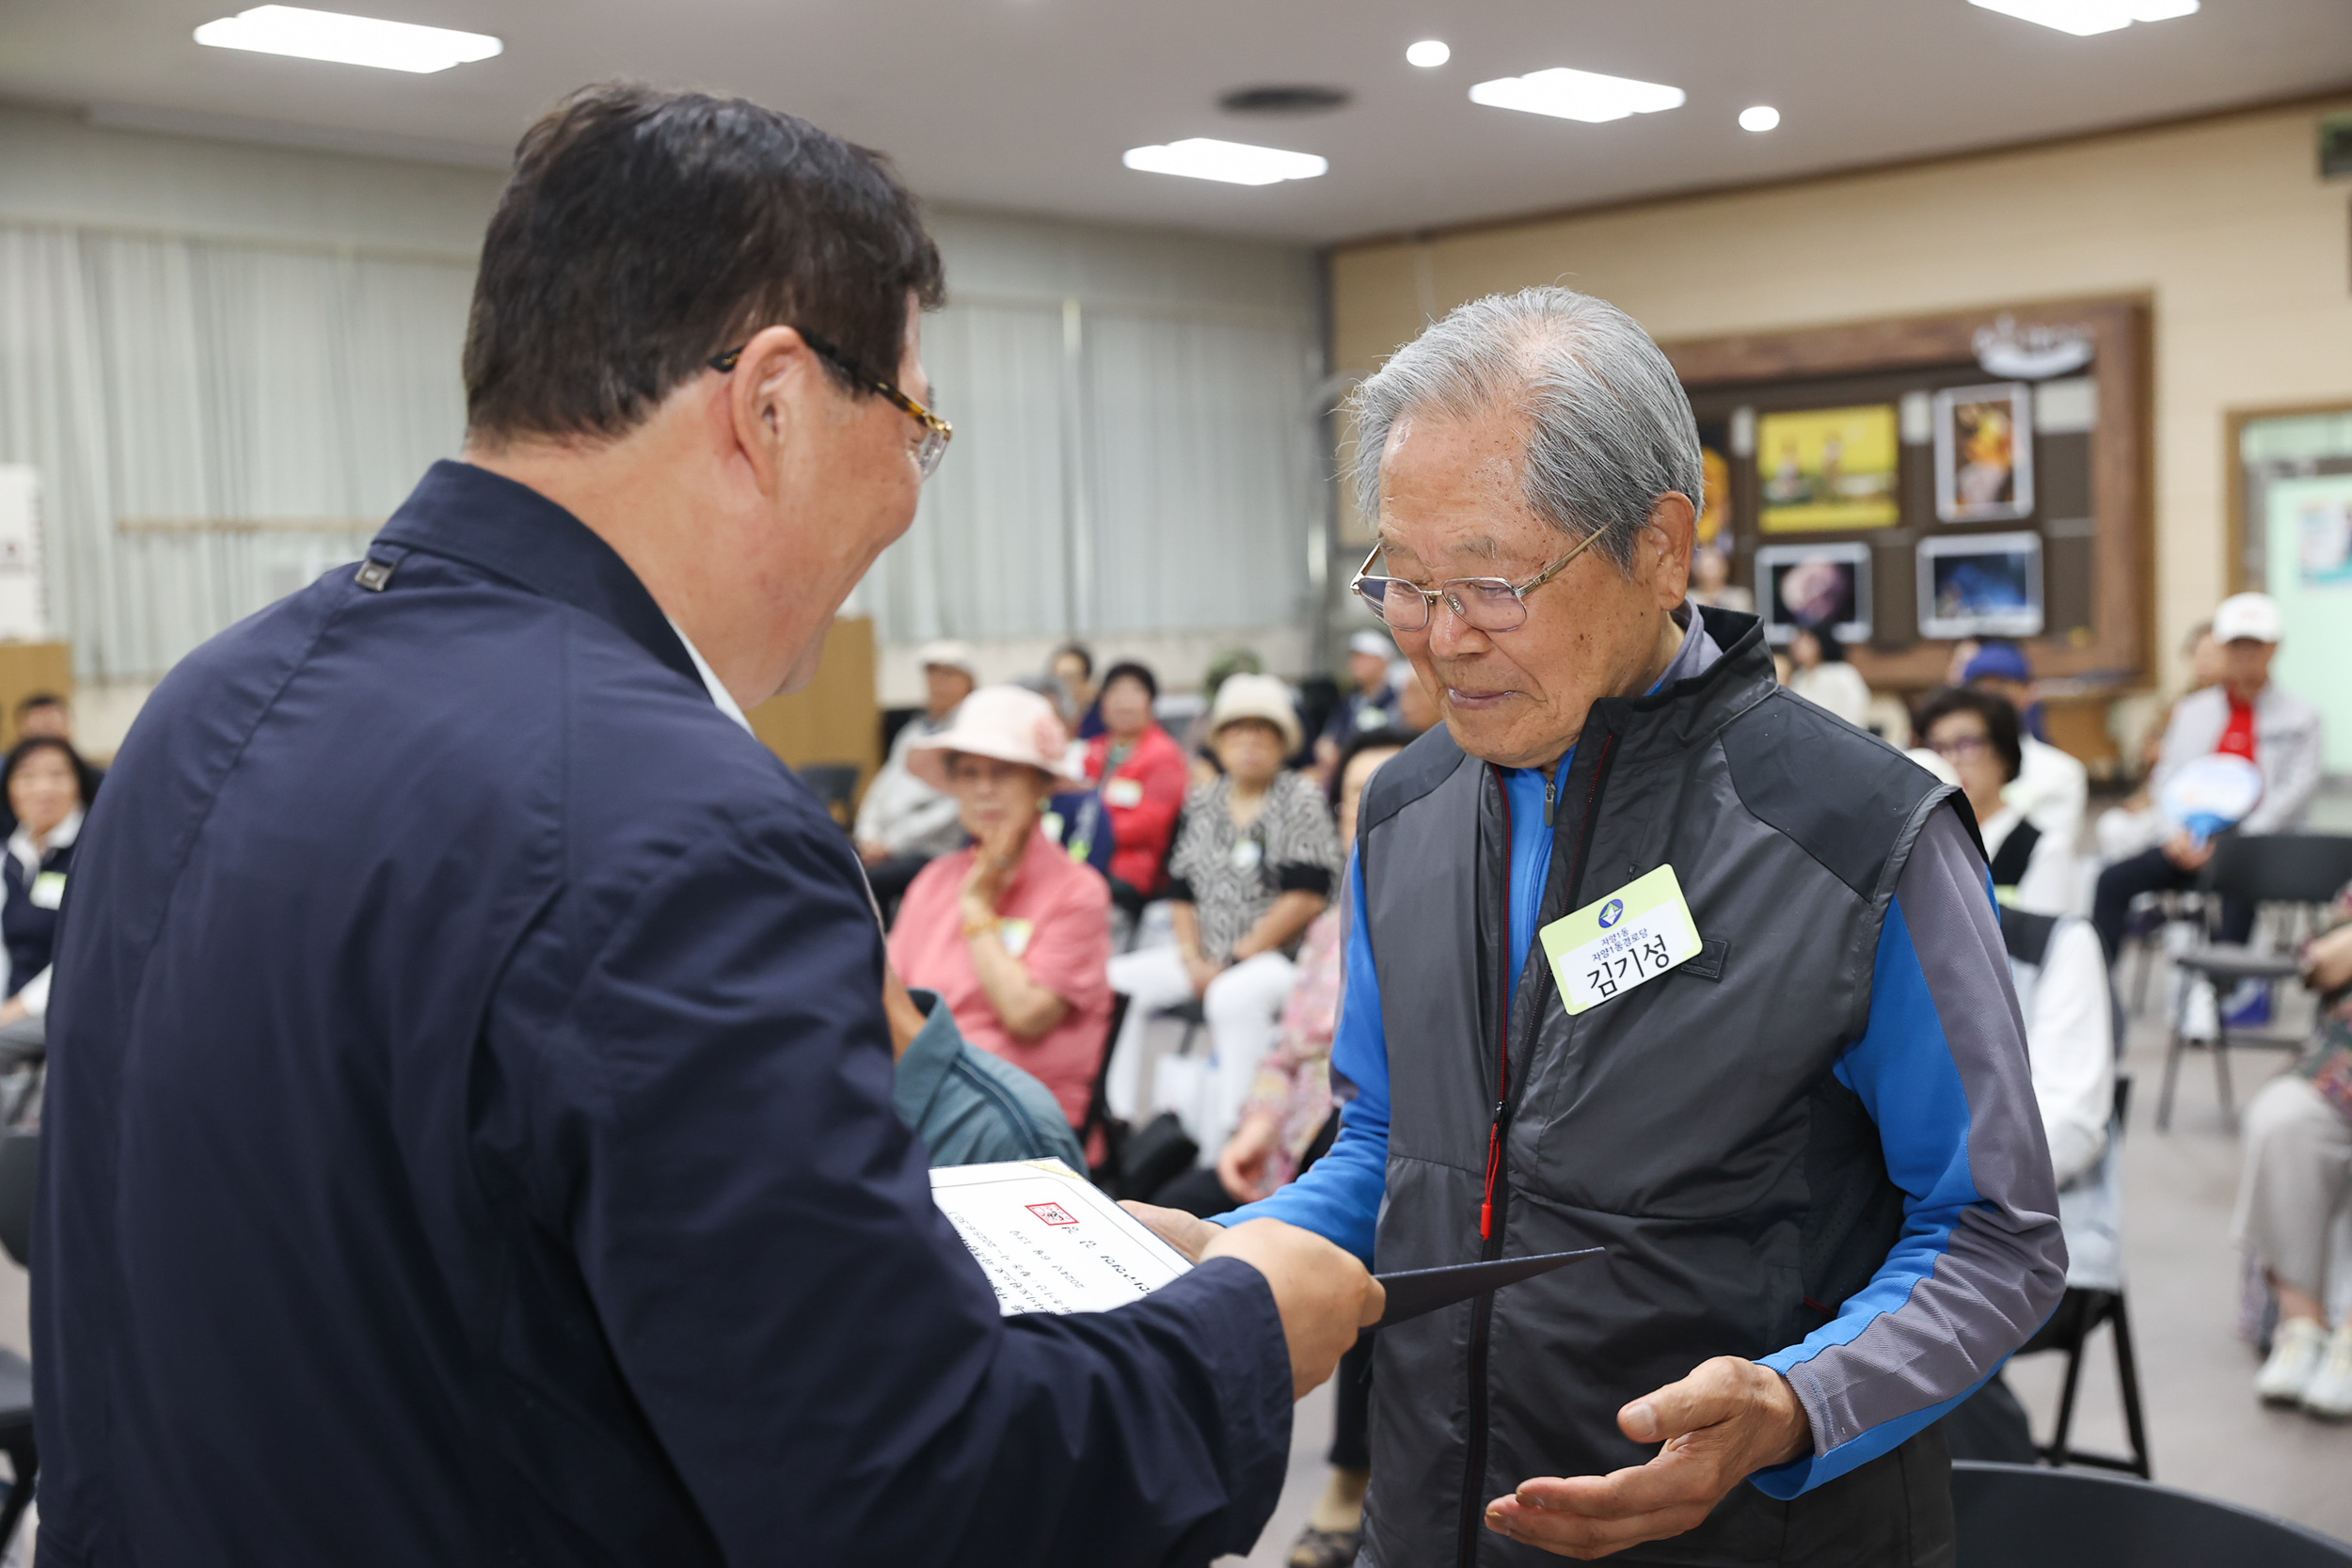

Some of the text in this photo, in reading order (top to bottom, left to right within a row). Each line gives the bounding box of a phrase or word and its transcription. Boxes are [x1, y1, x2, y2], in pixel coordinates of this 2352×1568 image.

[1592, 927, 1648, 962] 자양1동경로당
[1601, 927, 1629, 946] 자양1동
[1587, 934, 1670, 997] 김기성
